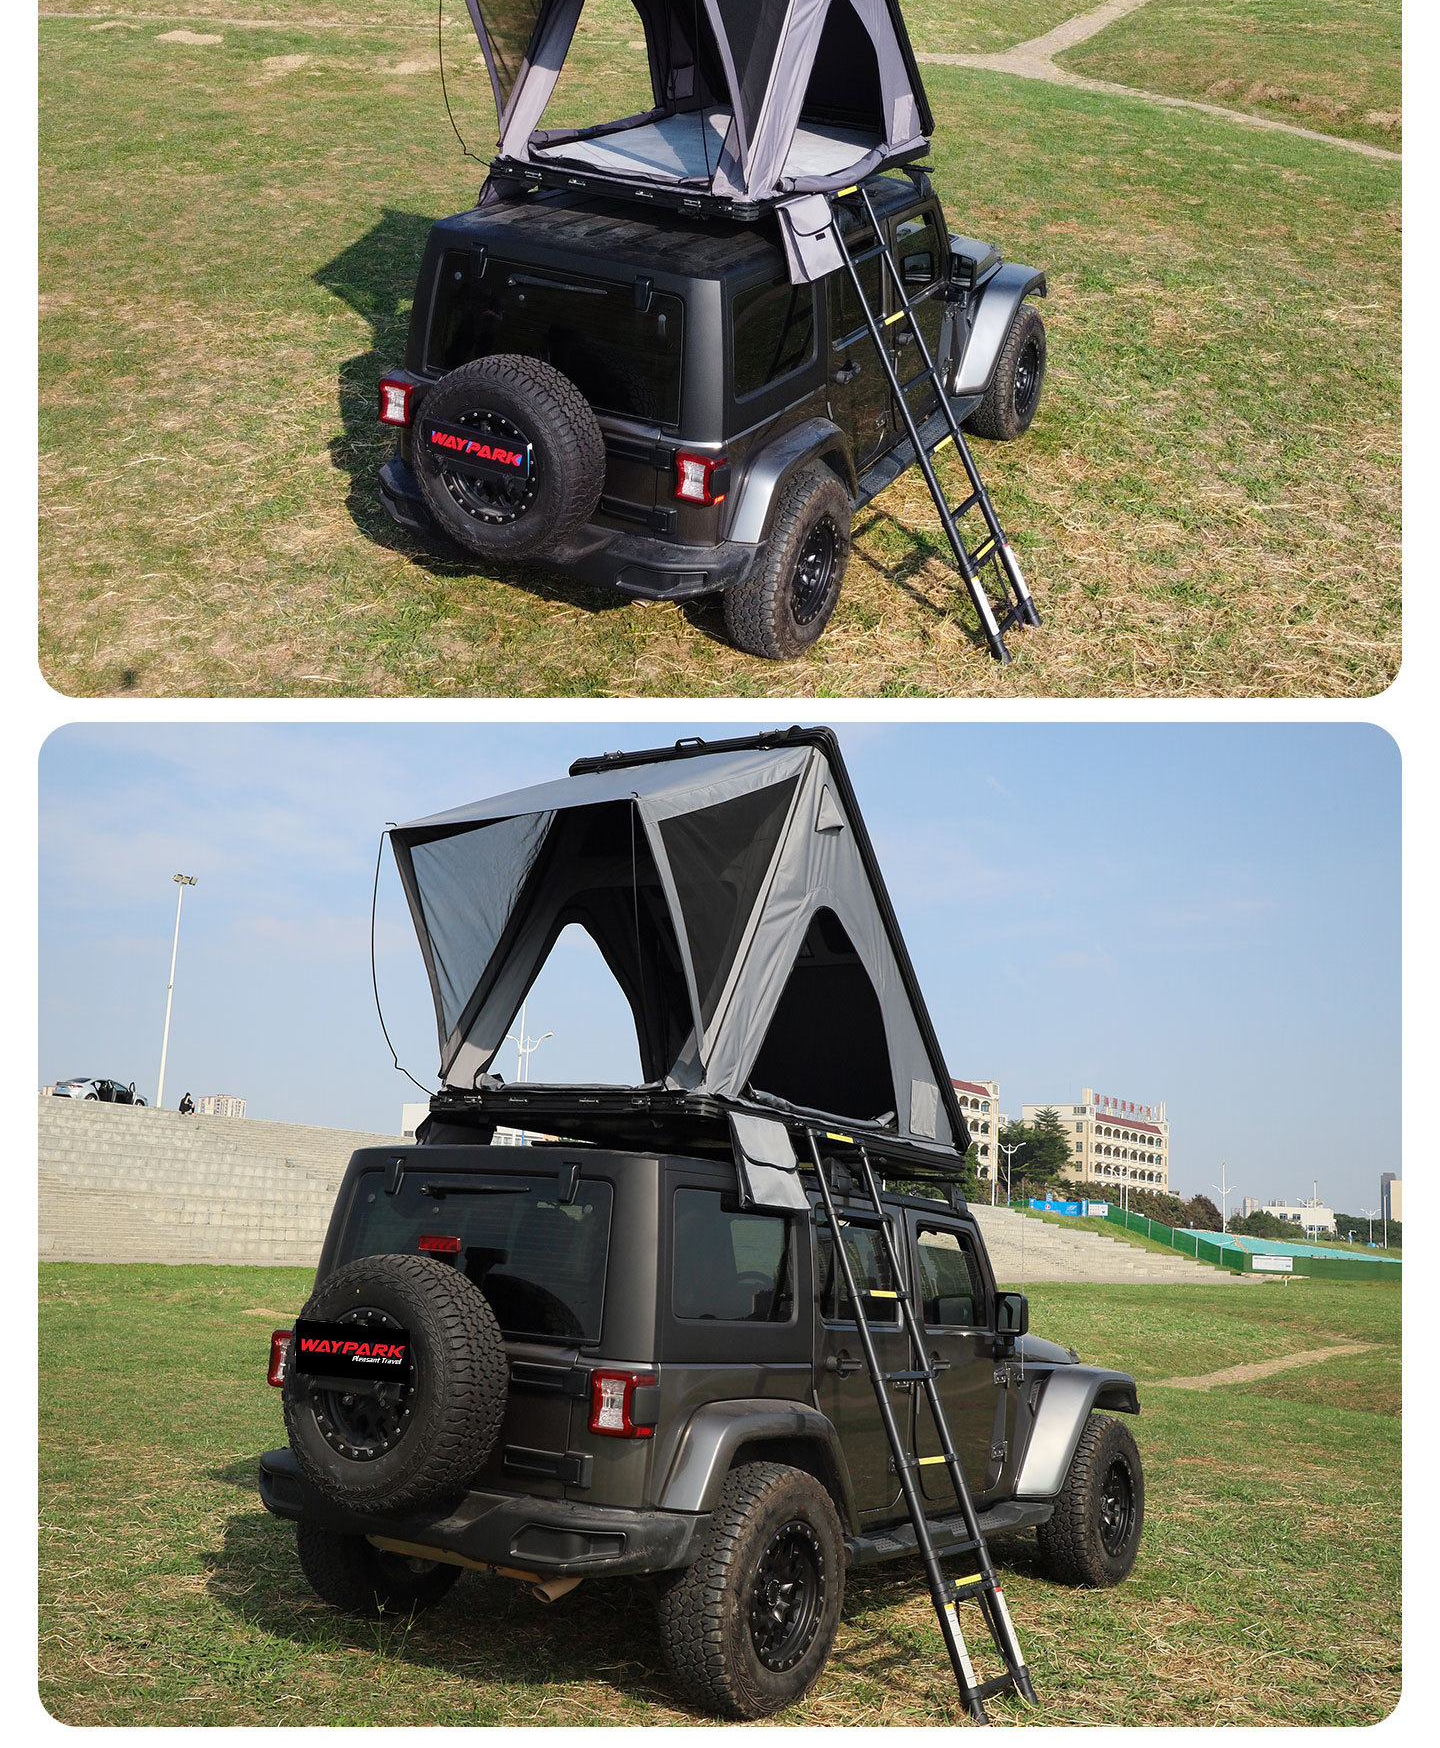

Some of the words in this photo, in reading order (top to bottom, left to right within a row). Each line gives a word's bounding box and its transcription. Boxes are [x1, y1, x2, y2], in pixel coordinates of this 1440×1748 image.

[431, 430, 523, 467] WAYPARK
[300, 1338, 406, 1359] WAYPARK
[351, 1354, 381, 1364] Pleasant
